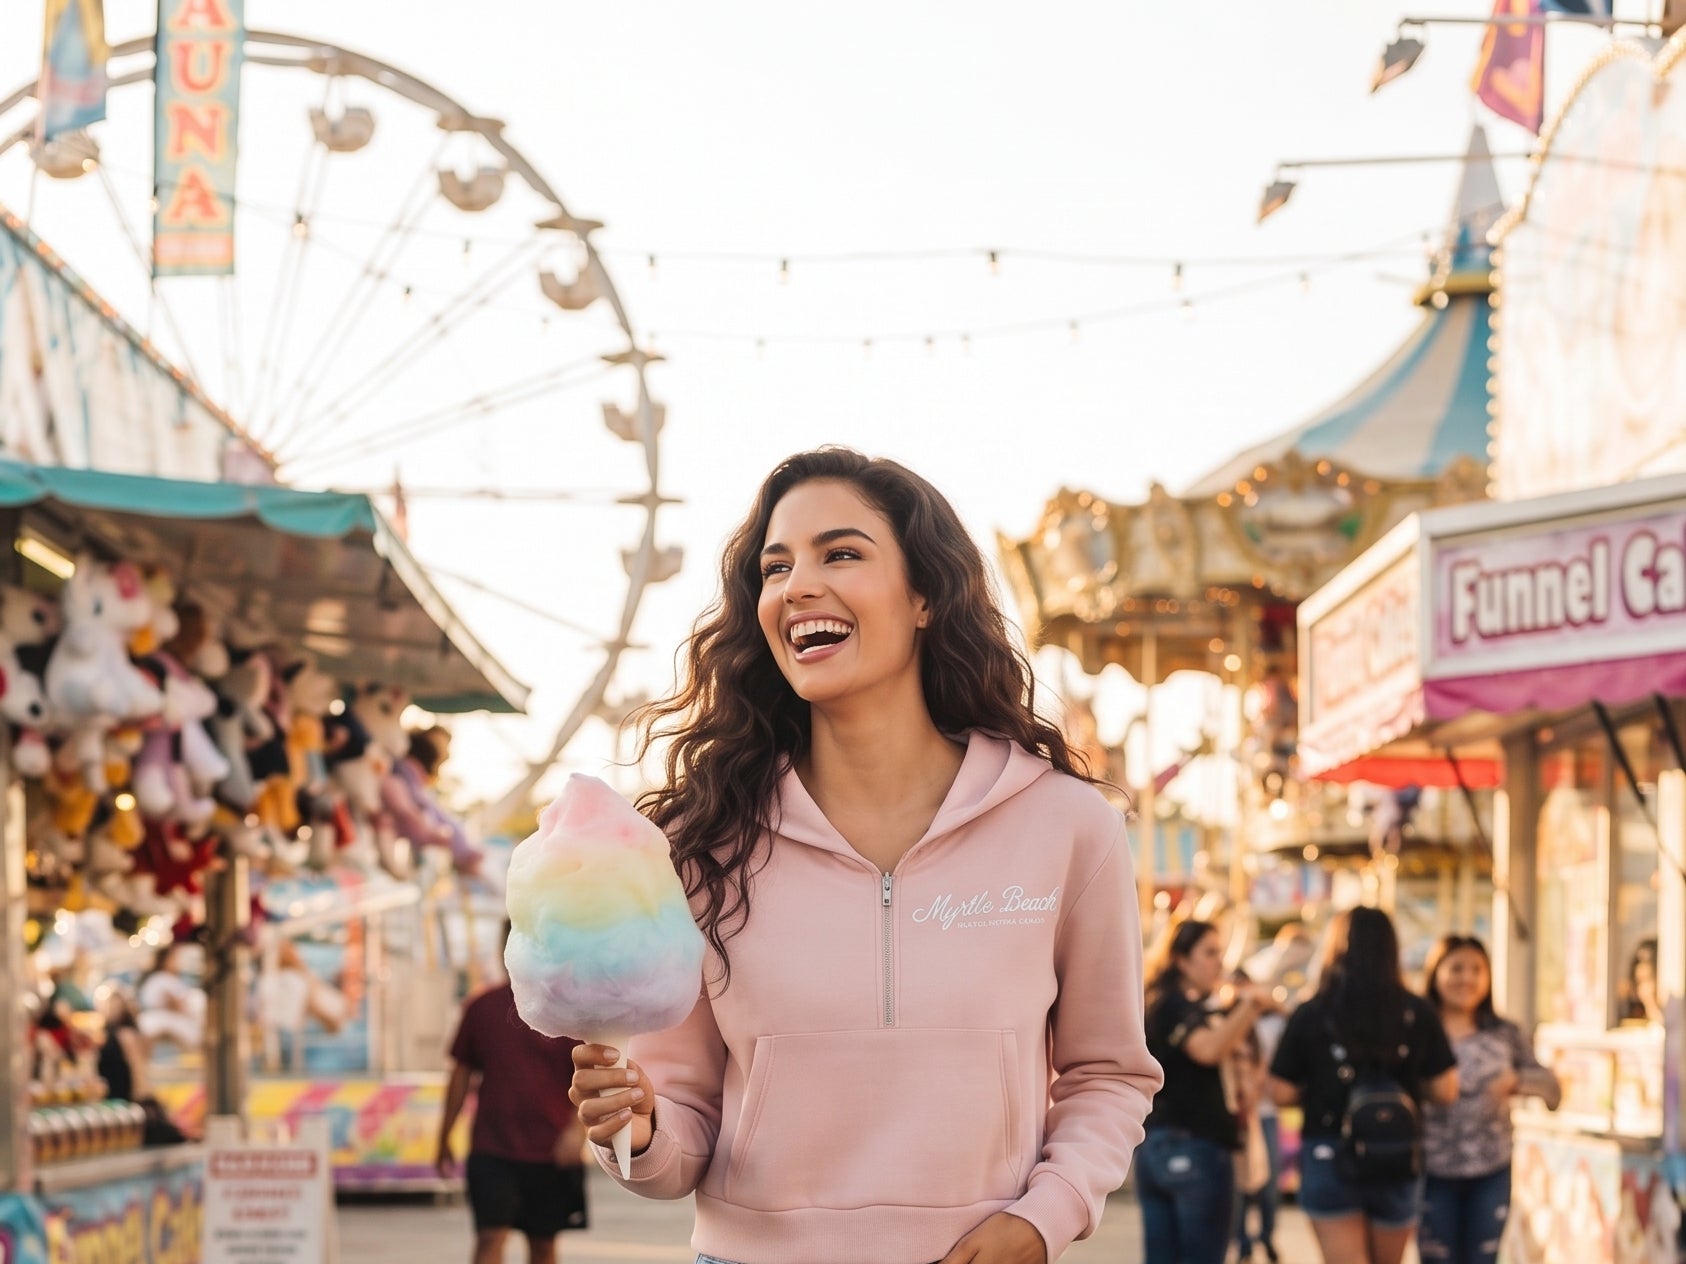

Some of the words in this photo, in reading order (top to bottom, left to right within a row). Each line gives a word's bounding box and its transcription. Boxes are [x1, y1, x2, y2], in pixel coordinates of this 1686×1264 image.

[1451, 537, 1610, 643] Funnel
[1621, 526, 1686, 619] Ca
[912, 890, 994, 930] Myrtle
[999, 885, 1060, 912] Beach
